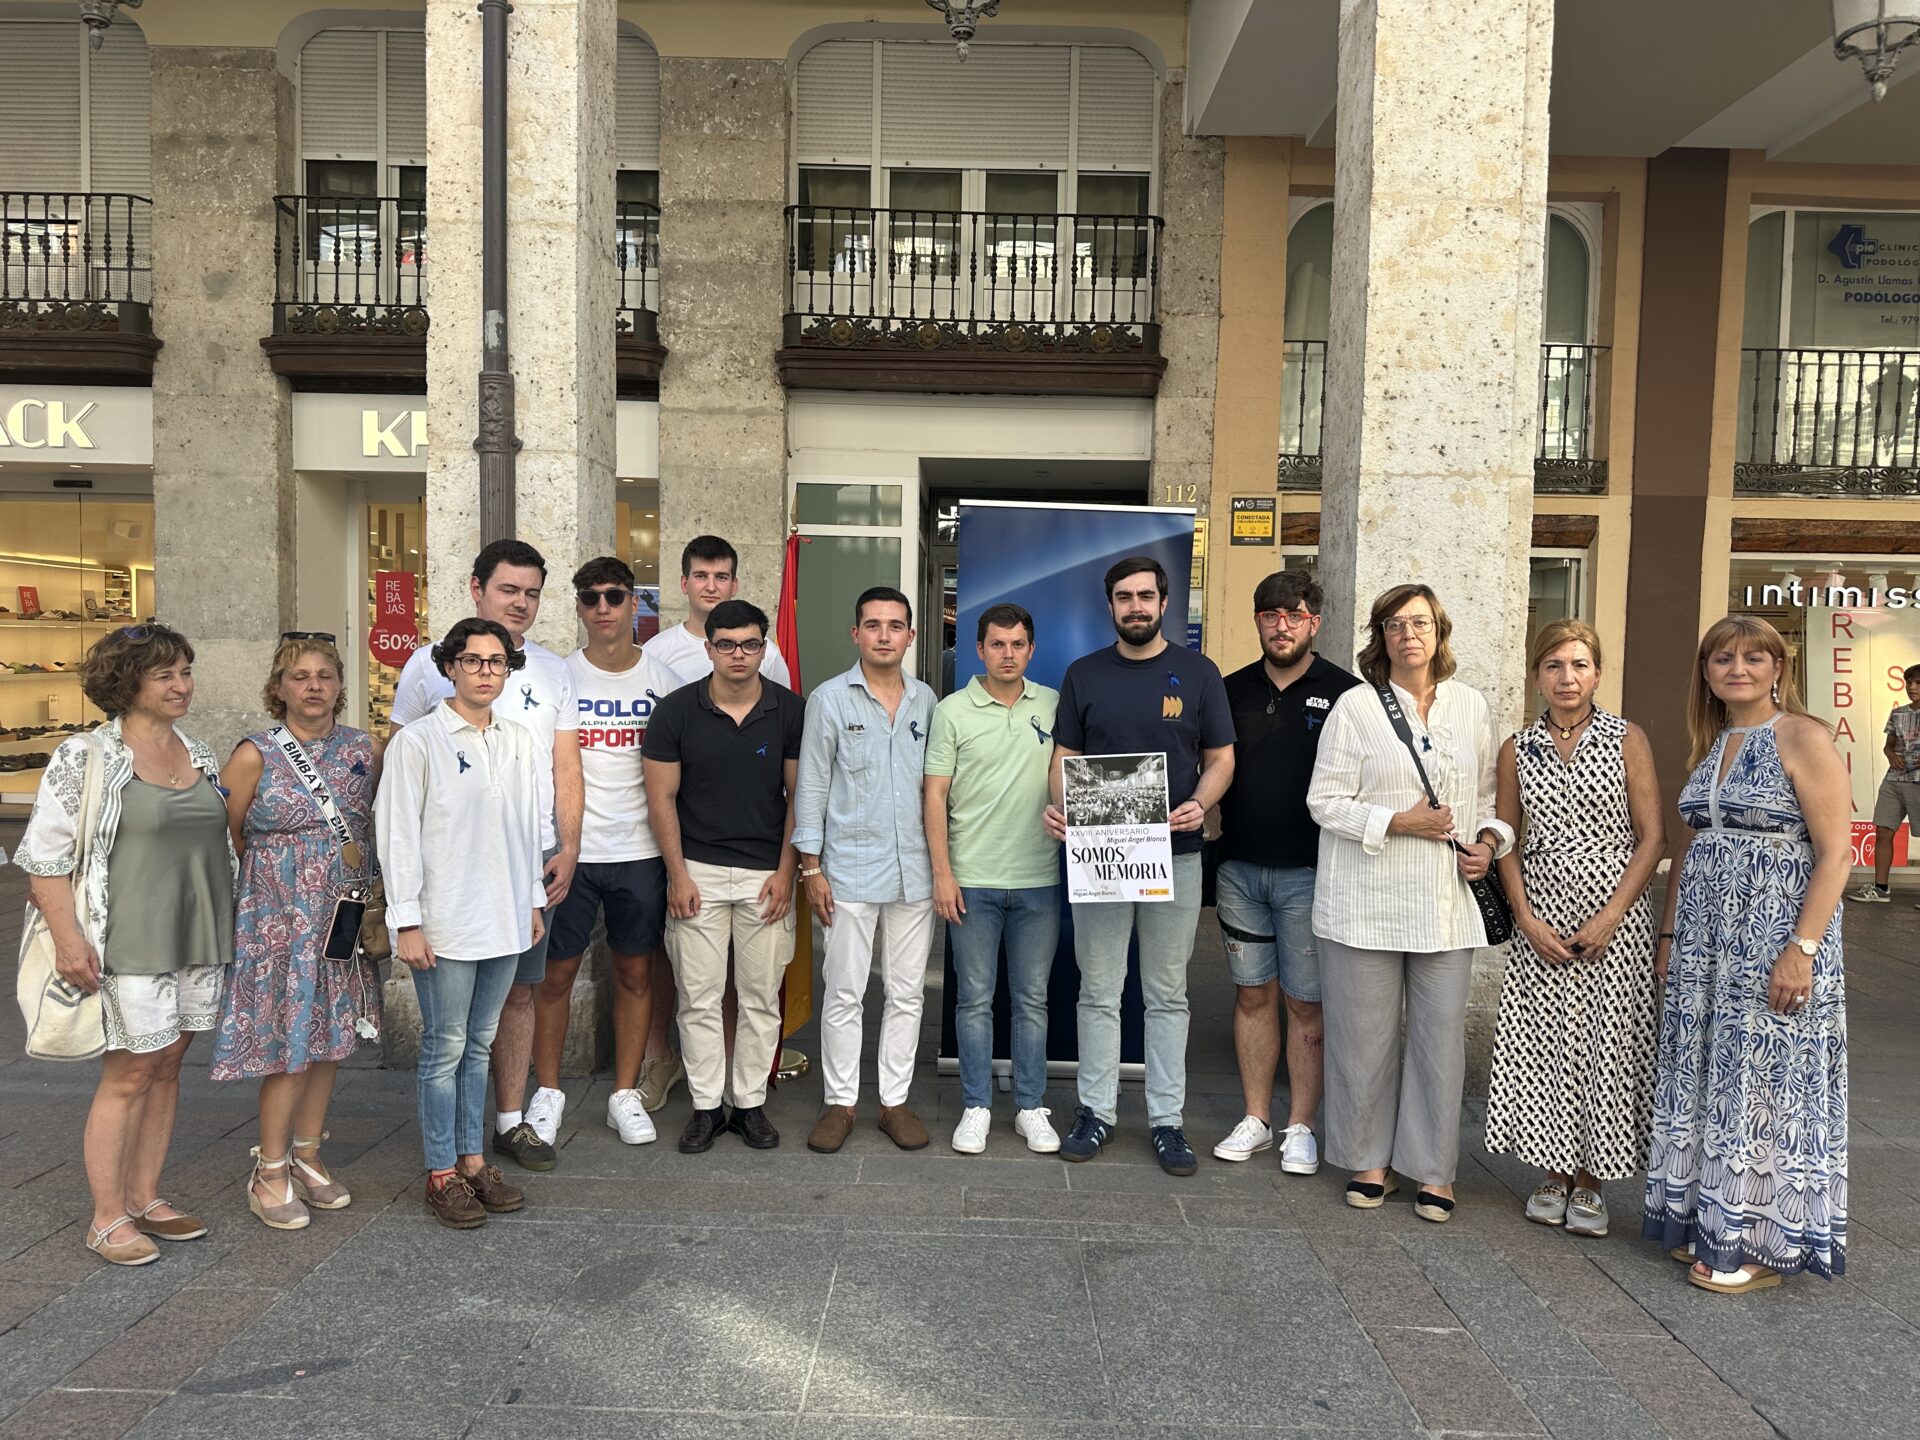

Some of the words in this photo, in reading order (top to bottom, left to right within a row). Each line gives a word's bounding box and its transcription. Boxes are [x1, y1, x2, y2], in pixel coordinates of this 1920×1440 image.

[1818, 274, 1829, 284] D.
[1834, 275, 1873, 287] Agustín
[1878, 275, 1913, 285] Llamas
[1901, 316, 1920, 325] 979
[1165, 484, 1197, 503] 112
[385, 580, 401, 591] RE
[385, 592, 402, 602] BA
[385, 604, 406, 615] JAS
[373, 634, 418, 650] -50%
[578, 699, 652, 717] POLO
[578, 728, 647, 747] SPORT
[283, 741, 317, 784] BIMBA
[1070, 829, 1093, 837] XXVIII
[1095, 828, 1149, 836] ANIVERSARIO
[1107, 837, 1128, 845] Miguel
[1071, 846, 1125, 864] SOMOS
[1094, 862, 1168, 881] MEMORIA
